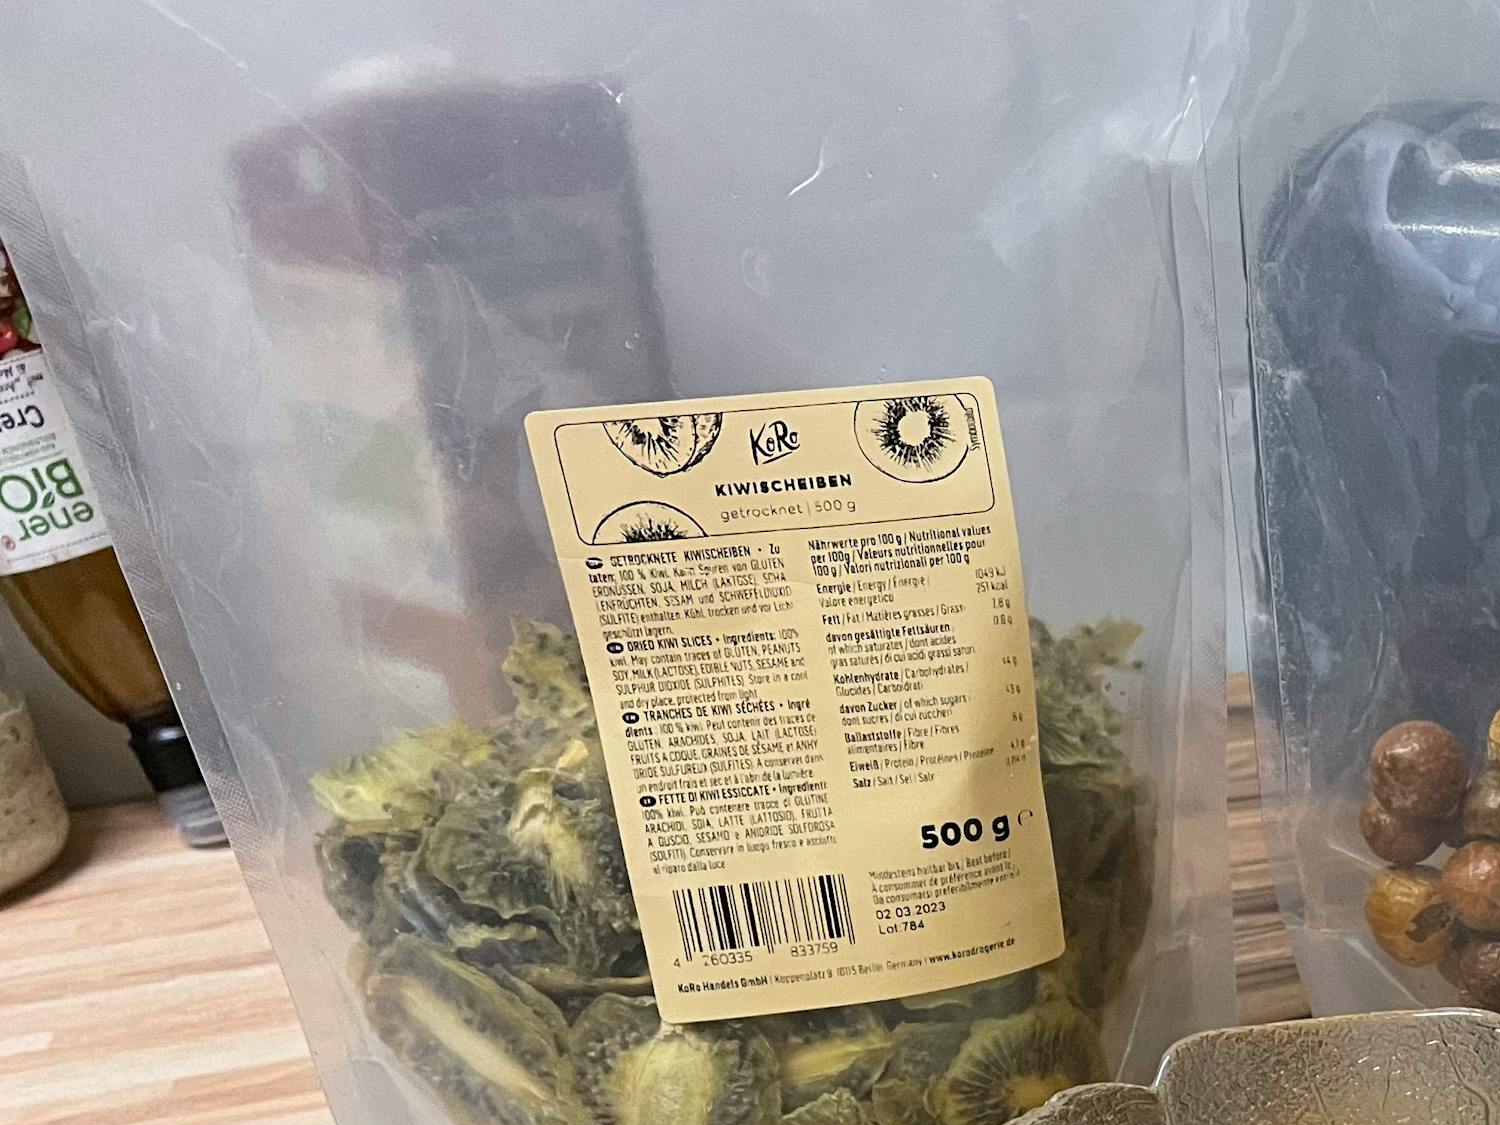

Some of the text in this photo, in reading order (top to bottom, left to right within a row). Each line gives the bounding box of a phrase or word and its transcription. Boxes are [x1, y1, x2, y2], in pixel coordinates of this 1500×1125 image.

[750, 420, 800, 465] KoRo
[714, 474, 852, 497] KIWISCHEIBEN
[720, 500, 856, 522] getrocknet 500 g
[808, 526, 991, 552] Nährwerte pro 100 g Nutritional values
[895, 541, 963, 556] nutritionnelles
[966, 540, 986, 552] pour
[684, 546, 751, 561] KIWISCHEIBEN
[813, 564, 829, 576] 100
[843, 561, 872, 574] Valori
[874, 556, 928, 571] nutrizionali
[930, 557, 944, 568] per
[946, 553, 962, 564] 100
[964, 555, 970, 565] g
[817, 583, 851, 594] Energie
[823, 614, 841, 625] Fett
[826, 630, 853, 642] davon
[902, 623, 951, 637] Fettsäuren
[627, 639, 655, 651] DRIED
[657, 637, 679, 649] KIWI
[681, 635, 713, 648] SLICES
[833, 670, 899, 685] Kohlenhydrate
[643, 699, 775, 722] TRANCHES DE KIWI SÉCHÉES
[840, 701, 897, 714] davon Zucker
[853, 778, 871, 788] Salz
[658, 793, 686, 805] FETTE
[700, 790, 720, 801] KIWI
[722, 786, 770, 799] ESSICCATE
[922, 815, 1010, 849] 500 g
[673, 942, 839, 968] 4 260335 833759
[703, 977, 740, 993] Handels
[741, 975, 768, 990] GmbH
